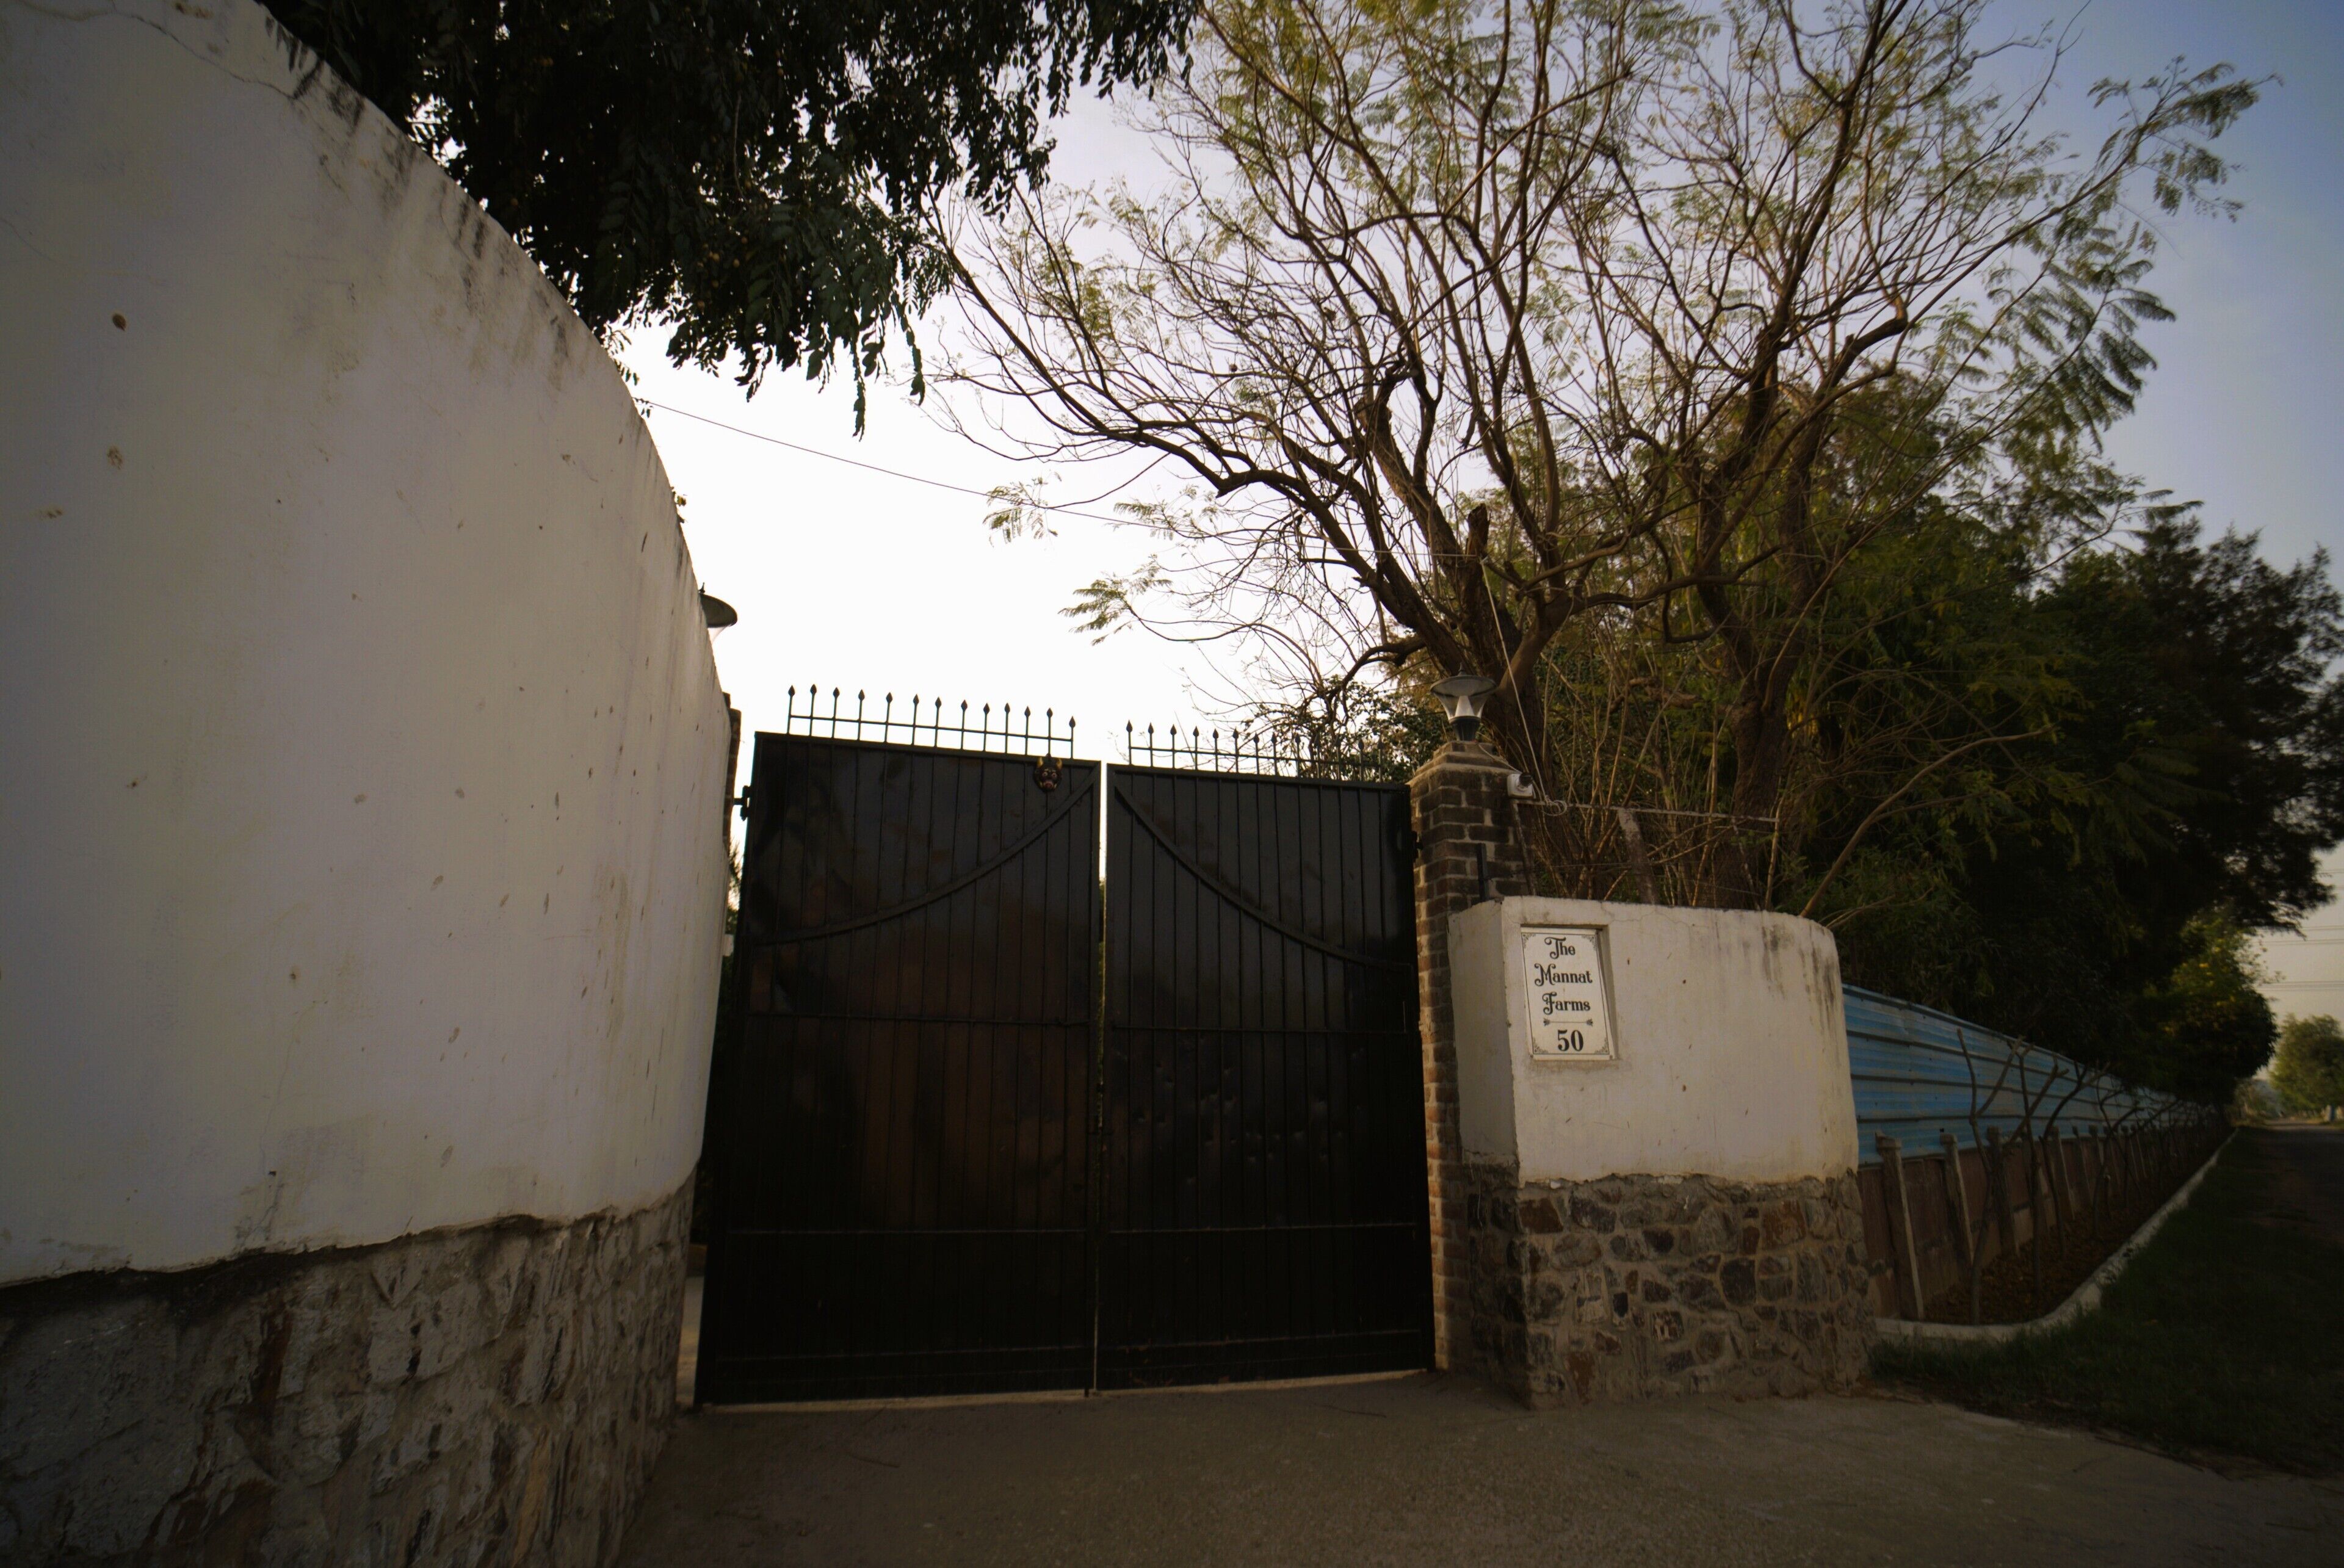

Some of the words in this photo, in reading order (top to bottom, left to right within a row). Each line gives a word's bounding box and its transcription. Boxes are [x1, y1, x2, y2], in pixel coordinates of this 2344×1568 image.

[1544, 936, 1575, 959] The
[1534, 963, 1593, 987] Mannat
[1542, 991, 1591, 1015] Farms
[1557, 1029, 1584, 1052] 50
